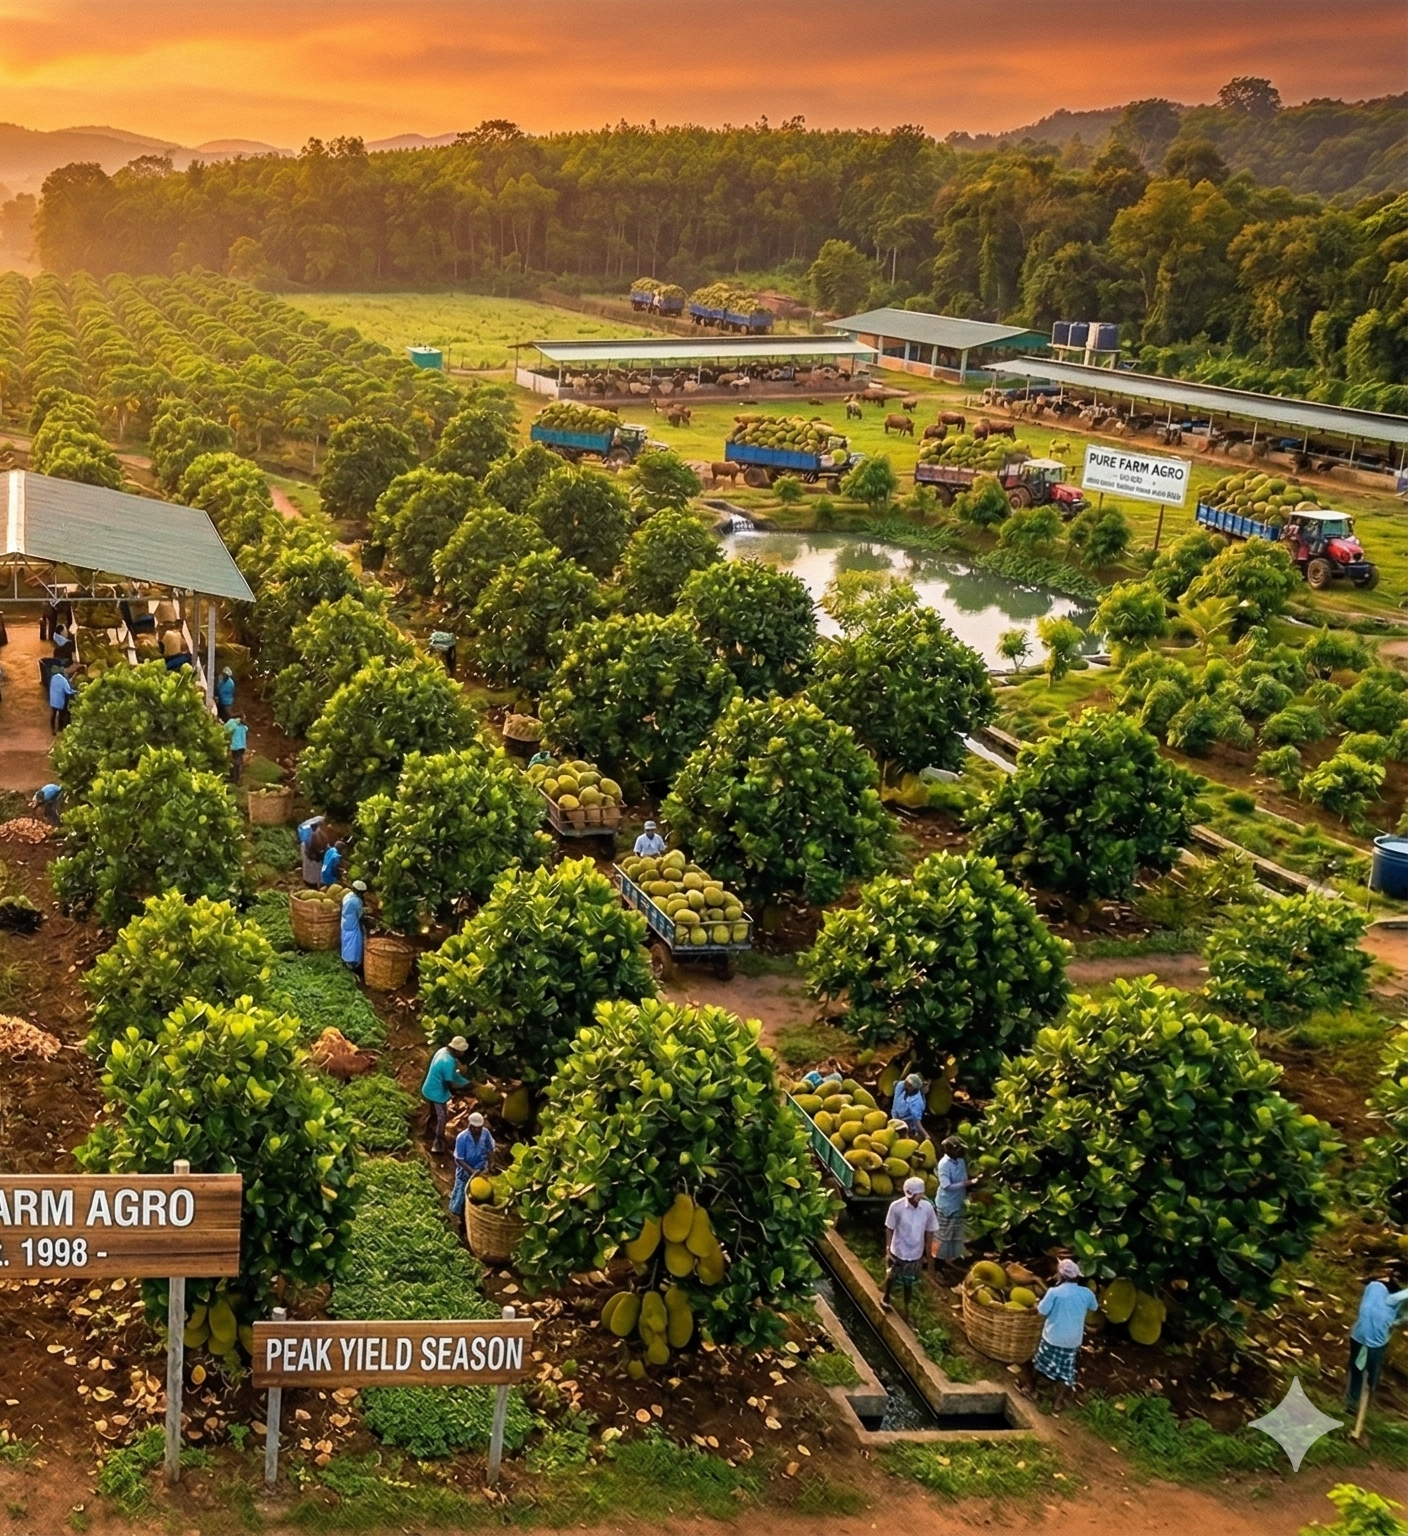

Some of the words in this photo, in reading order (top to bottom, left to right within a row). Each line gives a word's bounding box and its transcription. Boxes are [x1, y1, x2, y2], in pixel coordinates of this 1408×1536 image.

[1089, 453, 1117, 468] PURE
[1119, 458, 1149, 474] FARM
[1151, 464, 1184, 480] AGRO
[86, 1188, 195, 1227] AGRO
[21, 1237, 88, 1267] 1998
[266, 1337, 333, 1372] PEAK
[339, 1337, 413, 1371] YIELD
[420, 1336, 524, 1371] SEASON
